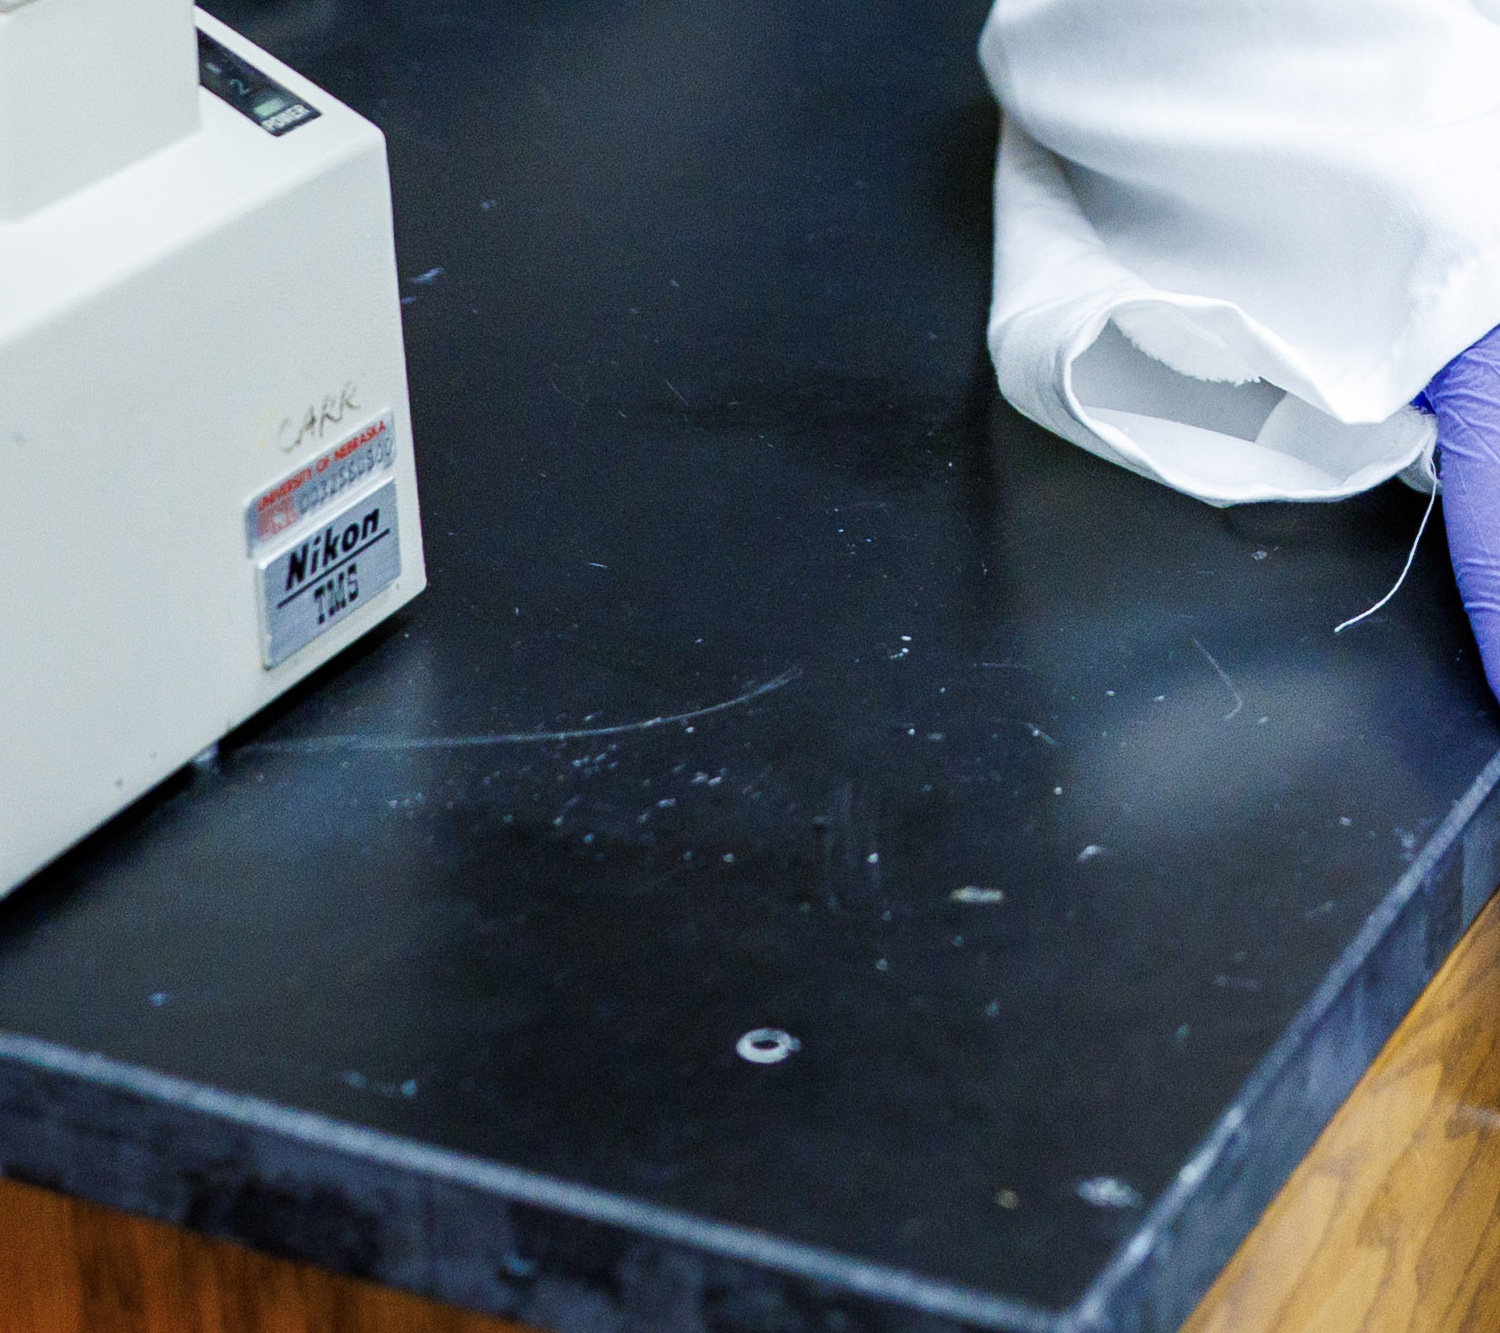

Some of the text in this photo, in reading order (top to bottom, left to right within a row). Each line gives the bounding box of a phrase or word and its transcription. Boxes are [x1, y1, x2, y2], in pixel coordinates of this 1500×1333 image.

[261, 103, 311, 132] POWER
[256, 420, 386, 511] UNIVERSITY OF NEBRASKA
[285, 507, 381, 592] Nikon
[313, 563, 360, 625] TMS
